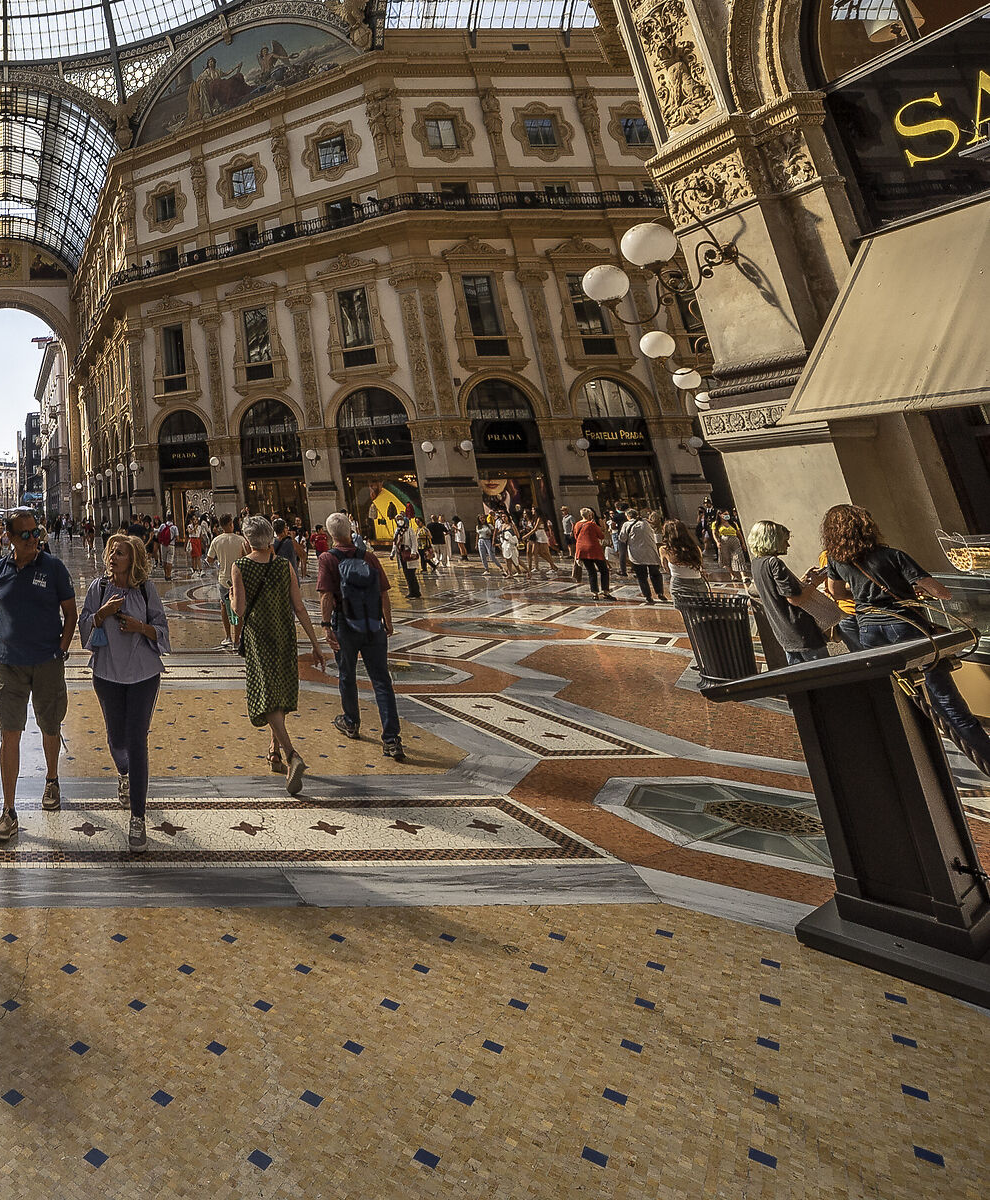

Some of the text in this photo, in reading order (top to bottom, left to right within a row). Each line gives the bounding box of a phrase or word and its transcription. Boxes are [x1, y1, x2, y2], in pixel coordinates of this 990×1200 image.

[487, 433, 522, 441] PRADA
[585, 429, 645, 440] FRATELLI PRADA
[357, 438, 392, 446] PRADA
[256, 445, 285, 454] PRADA
